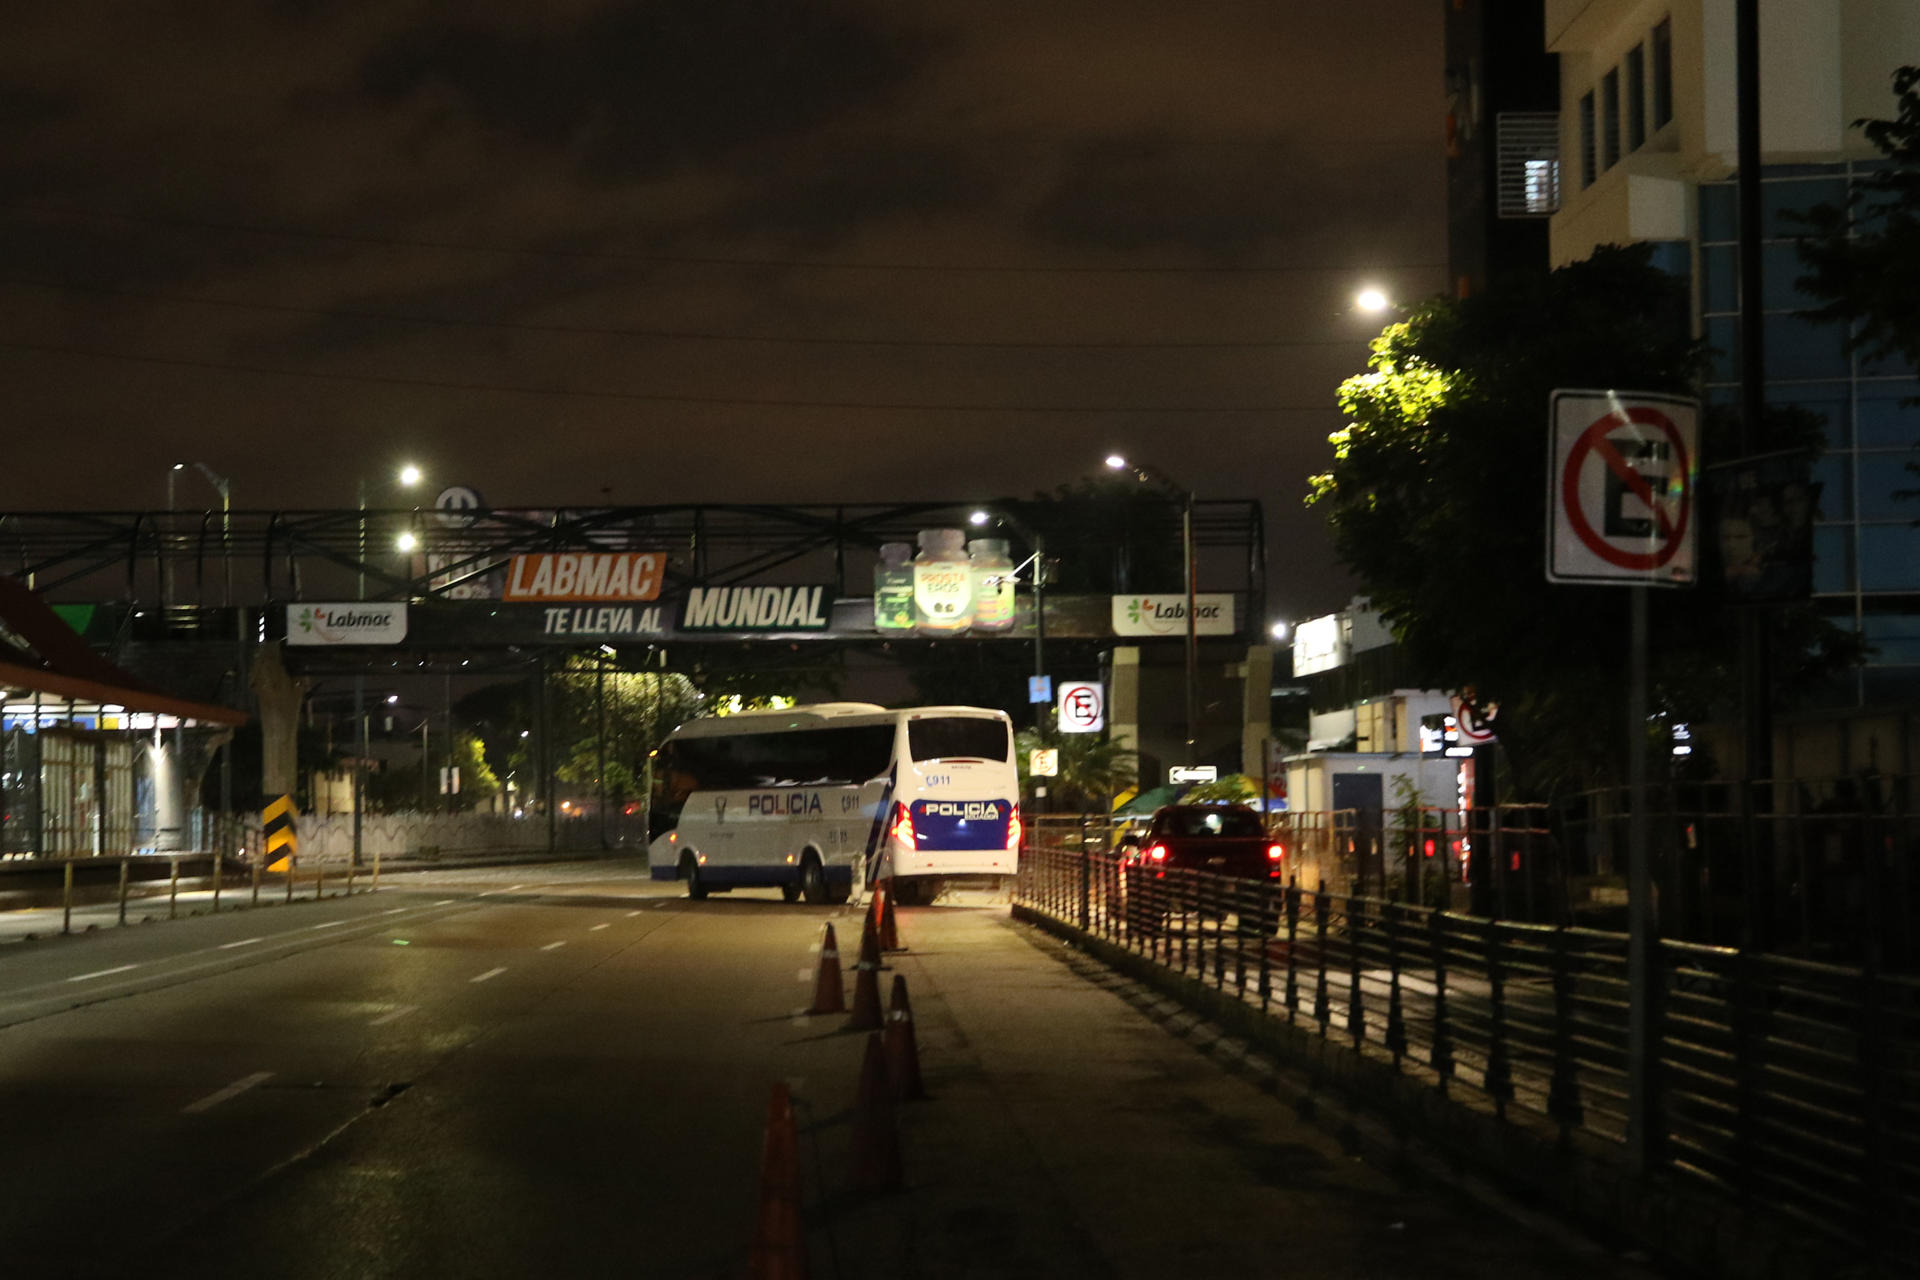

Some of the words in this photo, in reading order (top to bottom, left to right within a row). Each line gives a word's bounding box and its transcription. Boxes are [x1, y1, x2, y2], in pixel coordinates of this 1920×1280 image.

[509, 554, 656, 598] LABMAC
[327, 610, 392, 628] Labmac
[544, 608, 569, 634] TE
[571, 607, 634, 634] LLEVA
[635, 607, 664, 633] AL
[683, 586, 827, 628] MUNDIAL
